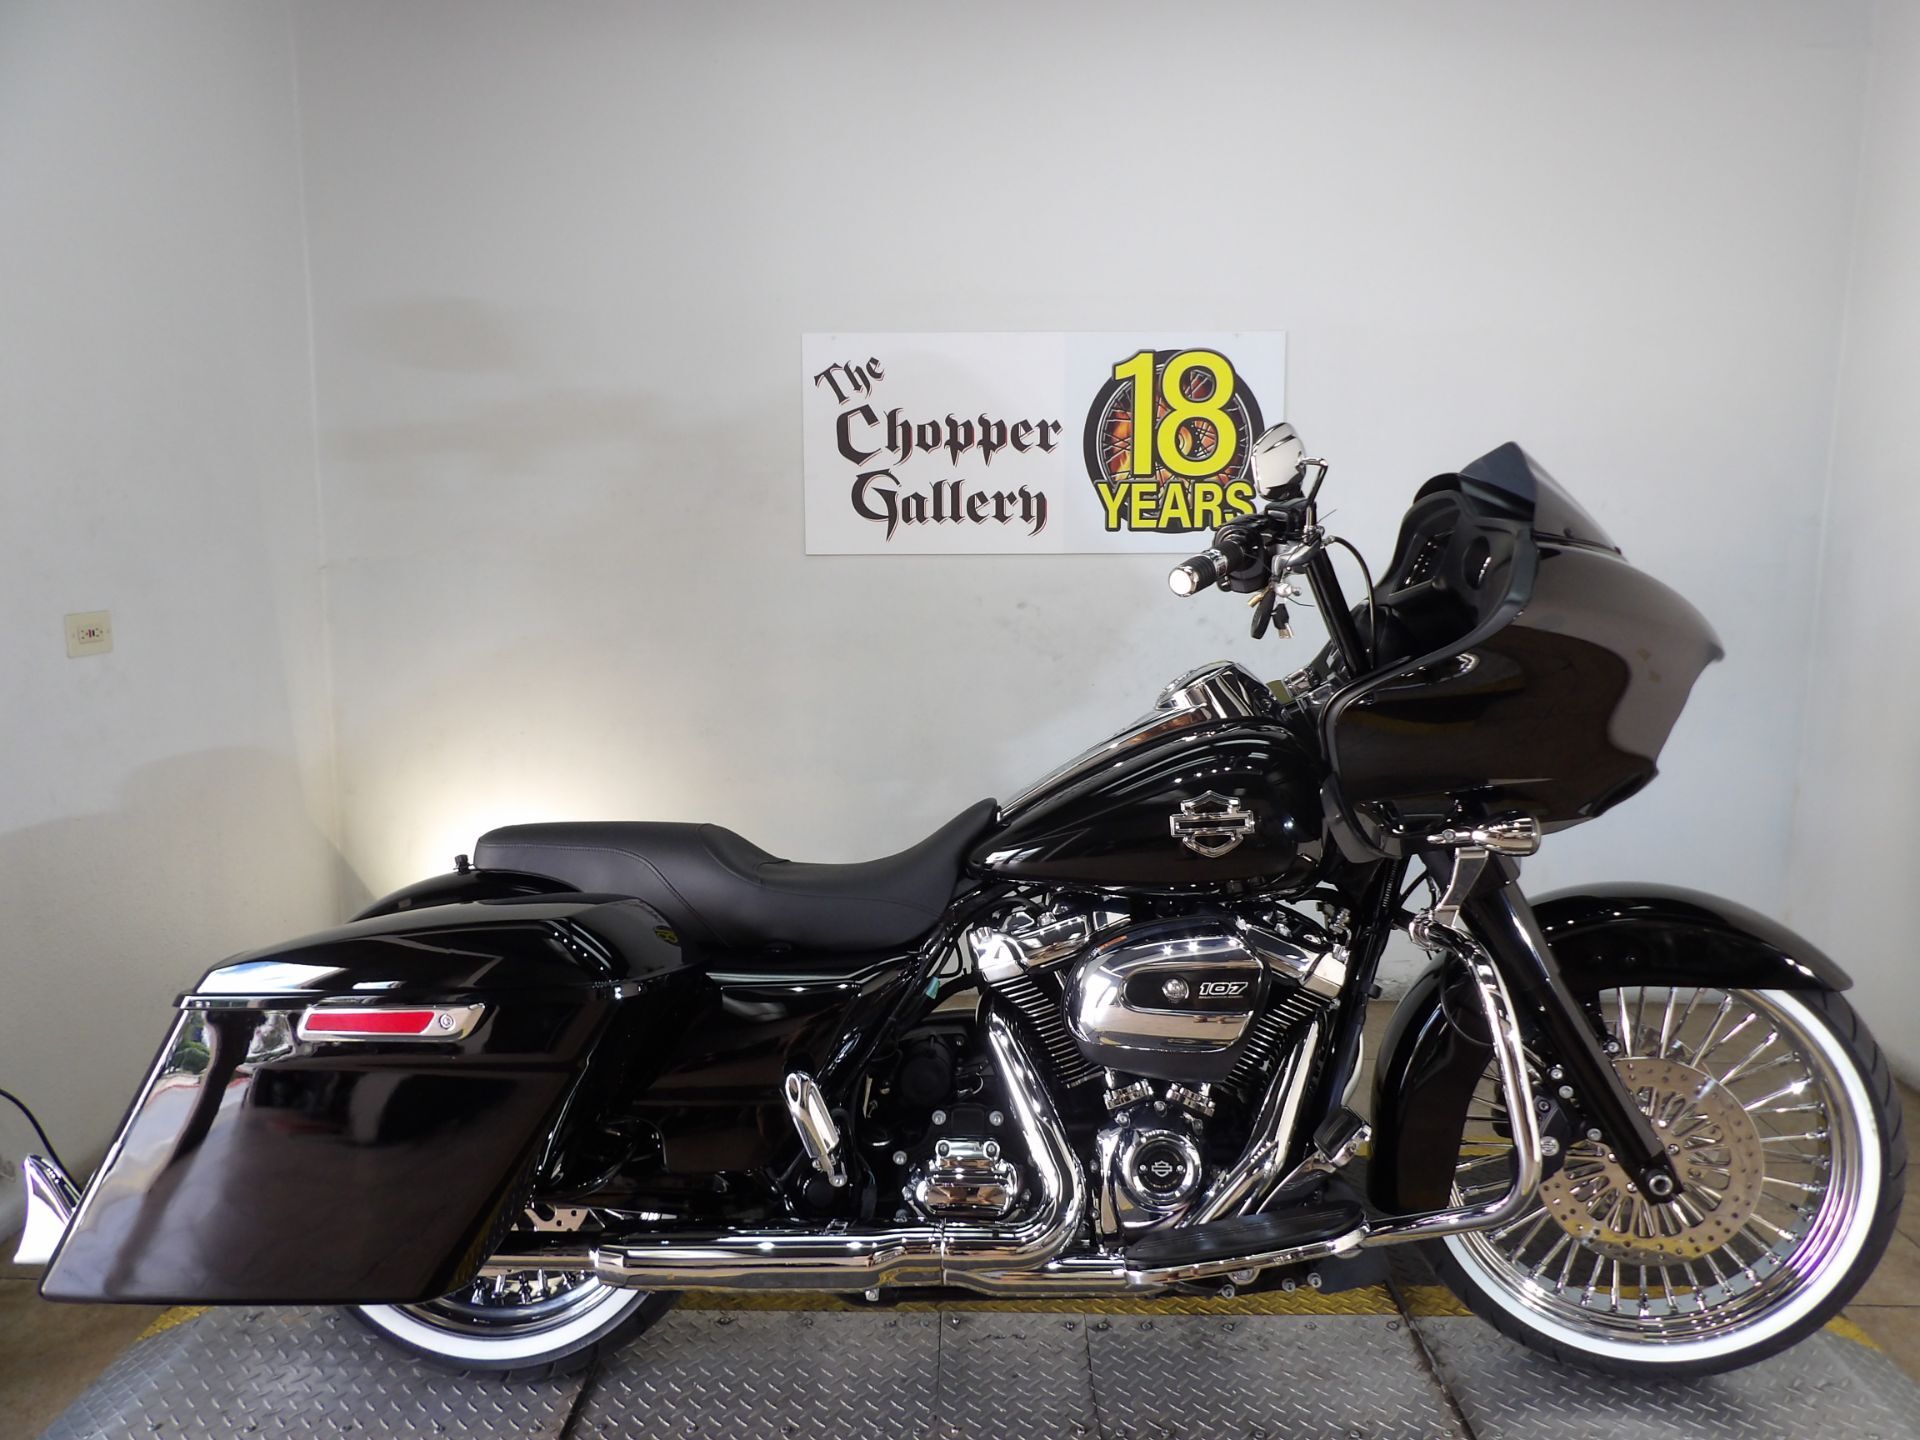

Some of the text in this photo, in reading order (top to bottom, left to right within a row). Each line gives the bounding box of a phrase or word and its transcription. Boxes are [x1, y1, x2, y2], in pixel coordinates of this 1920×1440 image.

[814, 357, 885, 405] The
[836, 404, 1063, 467] Chopper
[1112, 350, 1235, 475] 18
[851, 468, 1048, 542] Gallery
[1097, 482, 1256, 529] YEARS
[1199, 981, 1249, 995] 107
